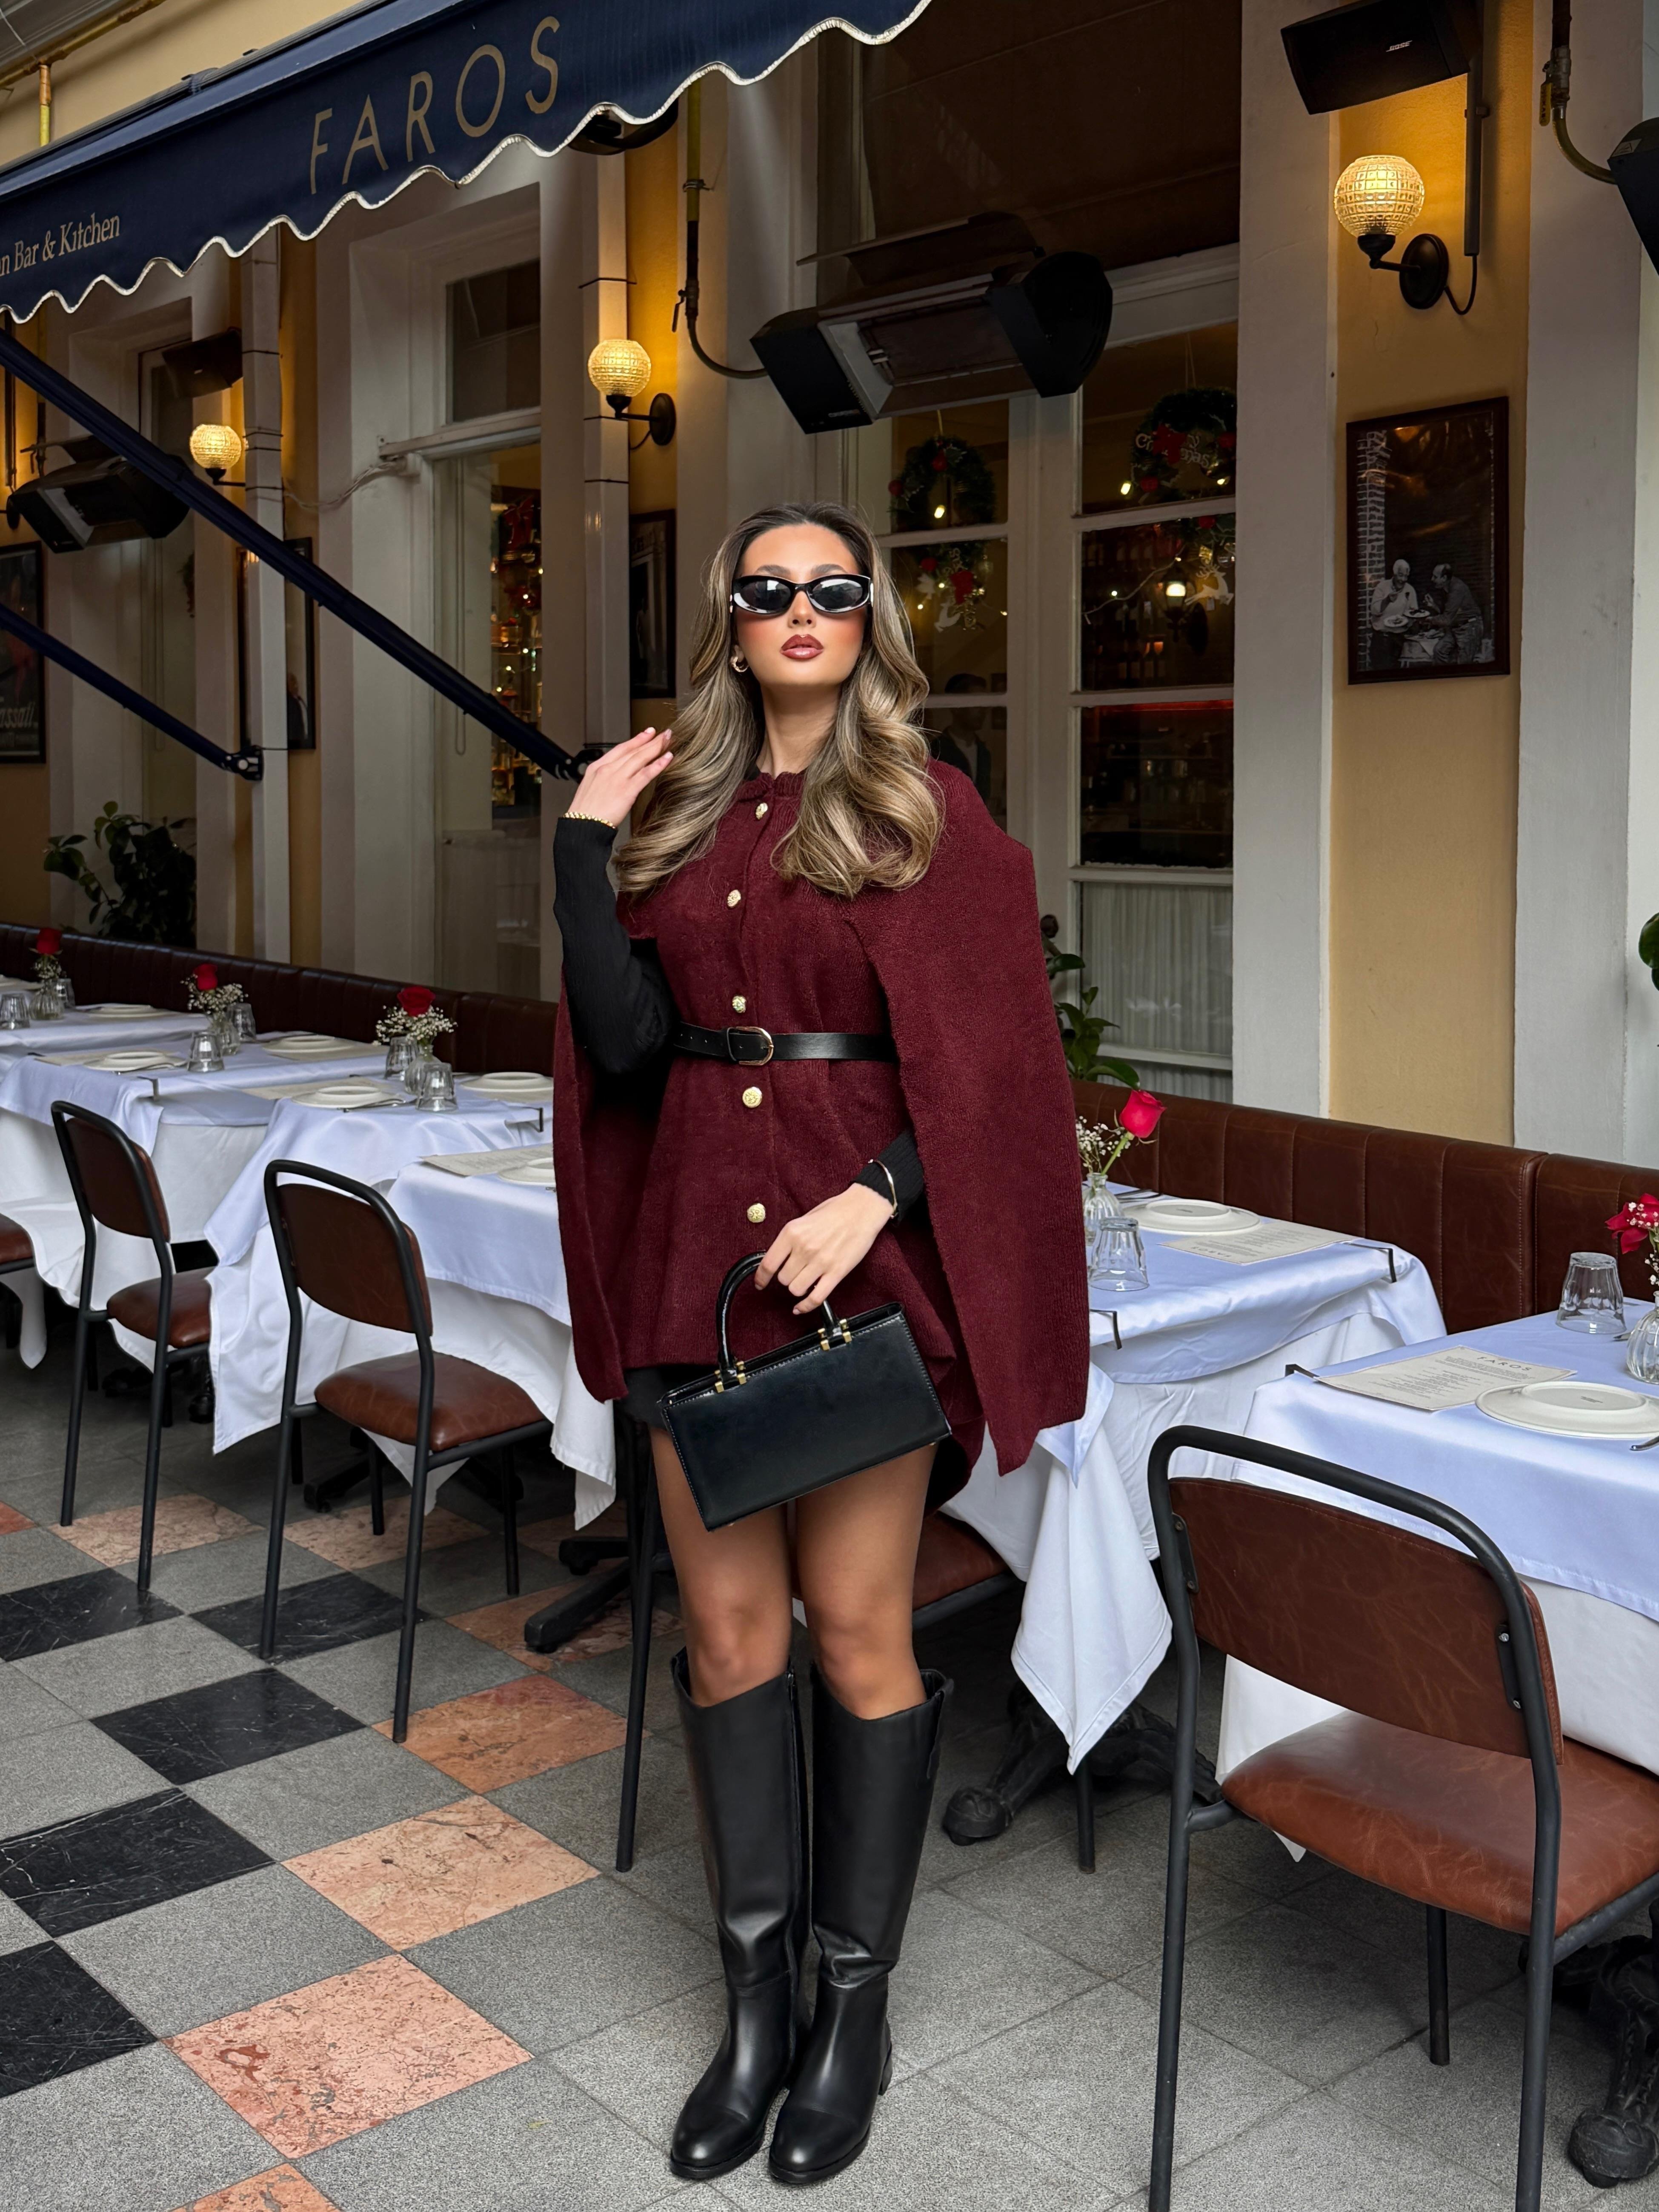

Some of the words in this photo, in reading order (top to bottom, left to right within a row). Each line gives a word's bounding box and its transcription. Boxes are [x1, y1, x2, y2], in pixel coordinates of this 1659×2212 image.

[310, 16, 560, 194] FAROS
[14, 240, 40, 272] Bar
[43, 230, 57, 262] &
[1476, 1356, 1532, 1371] FAROS
